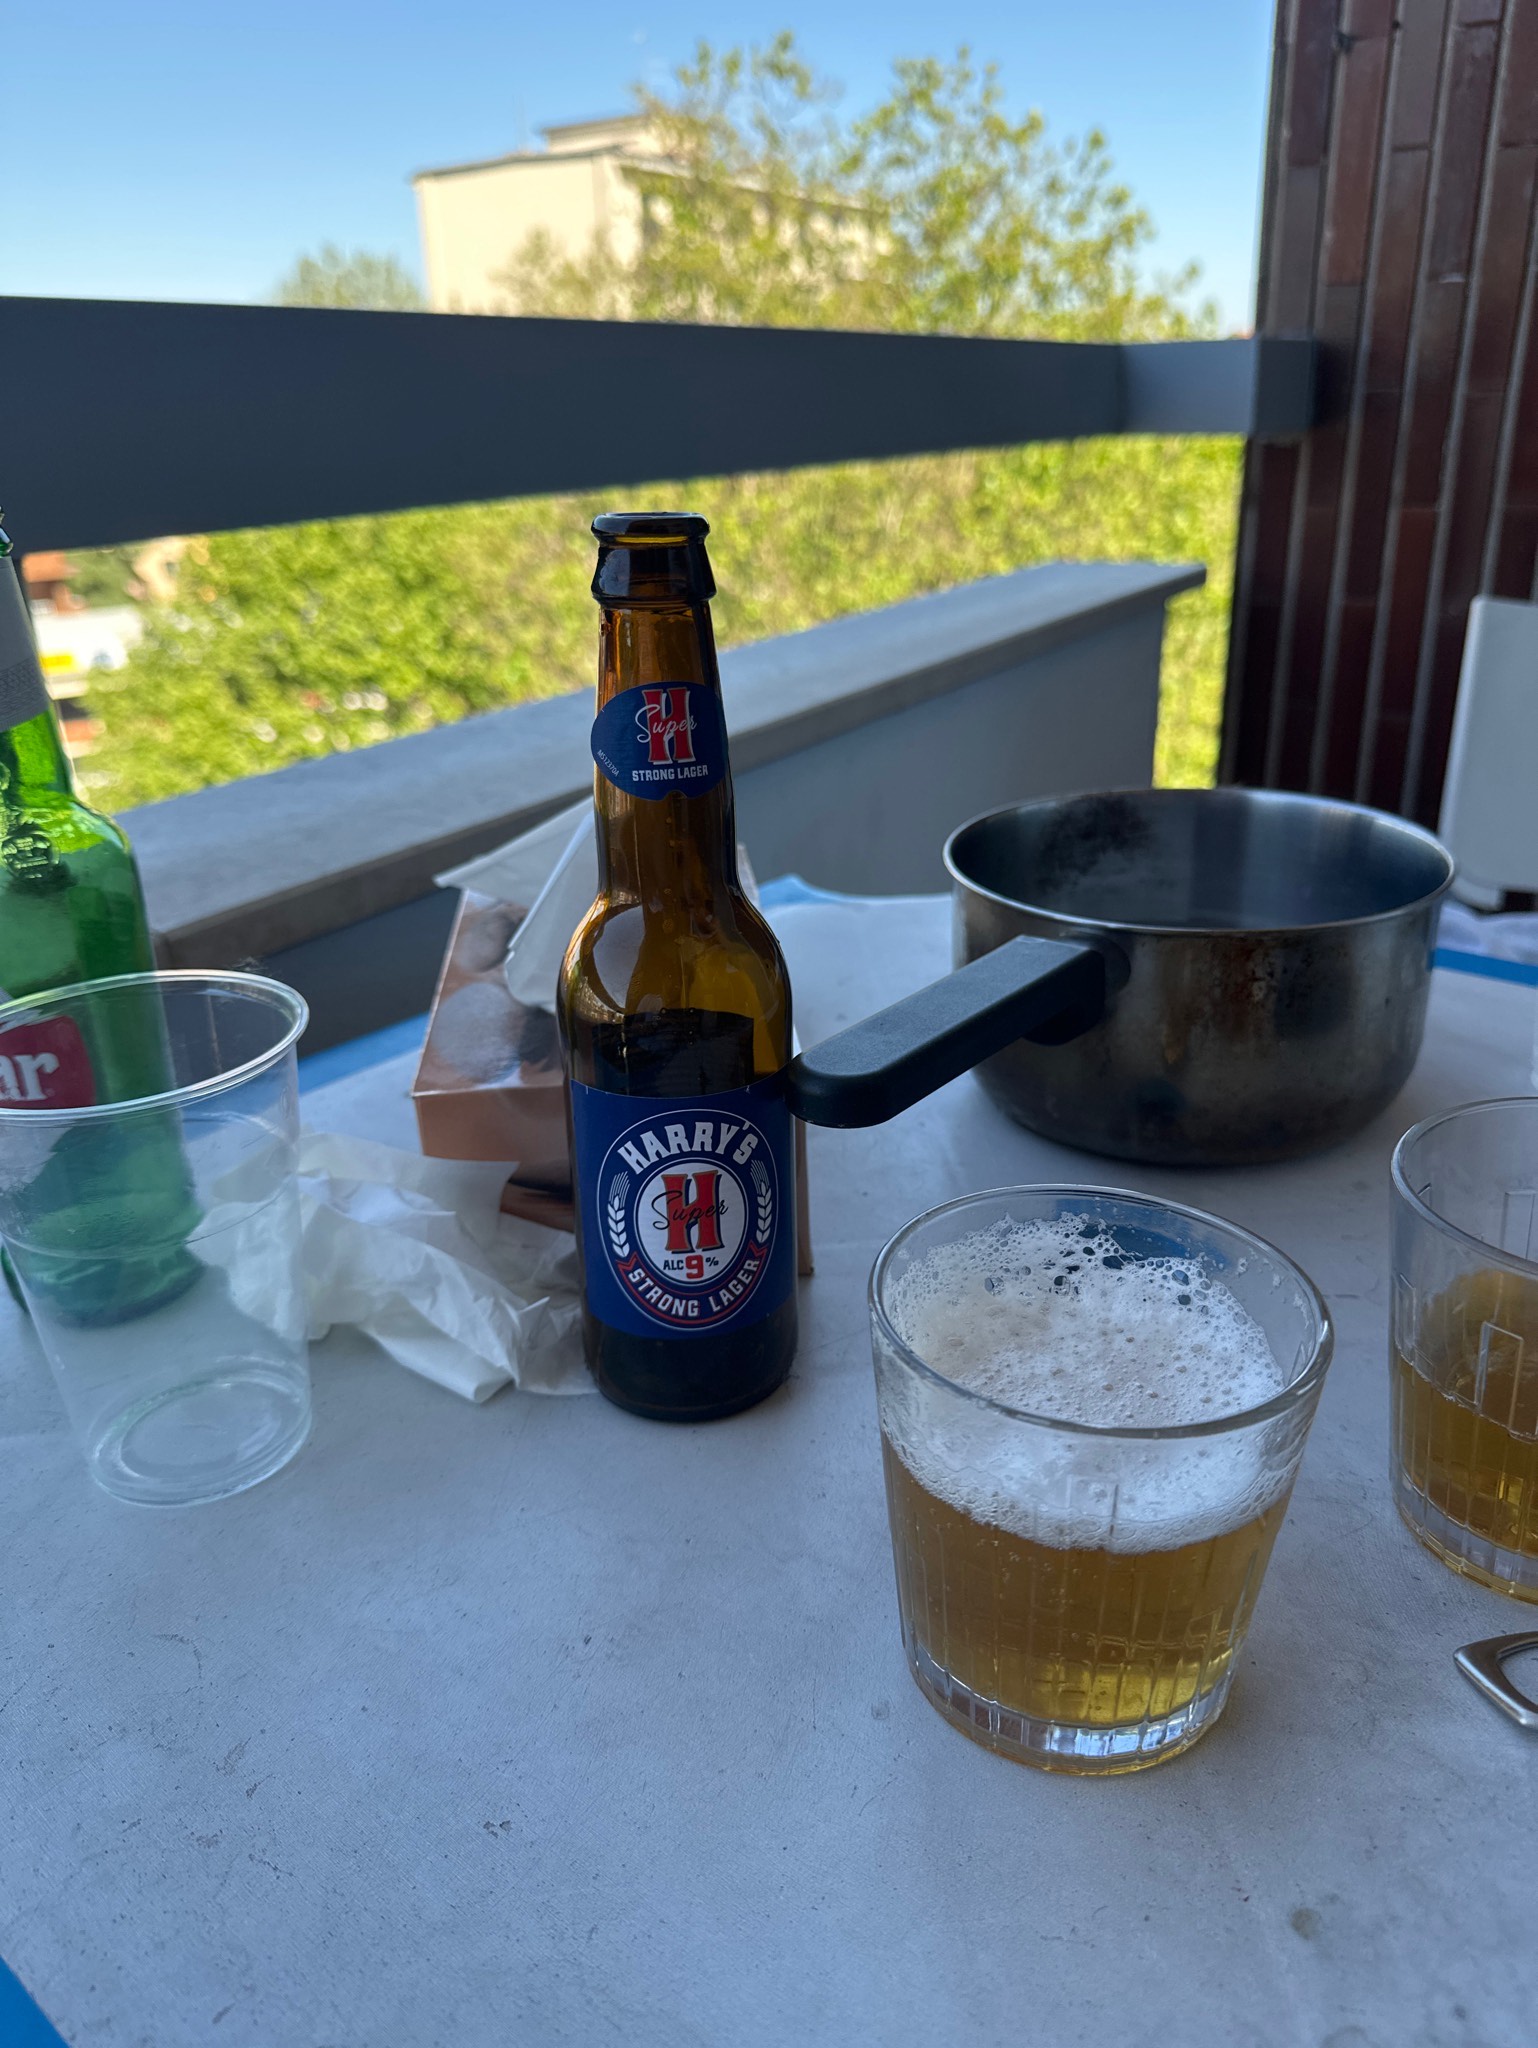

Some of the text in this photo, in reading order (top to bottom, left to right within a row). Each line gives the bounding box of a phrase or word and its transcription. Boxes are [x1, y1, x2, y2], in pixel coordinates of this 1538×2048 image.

[635, 704, 697, 743] Super
[642, 687, 696, 766] H
[632, 765, 709, 781] STRONG LAGER
[617, 1121, 759, 1175] HARRY'S
[651, 1190, 729, 1231] Super
[661, 1169, 725, 1254] H
[628, 1258, 760, 1317] STRONG LAGER
[663, 1259, 684, 1271] ALC
